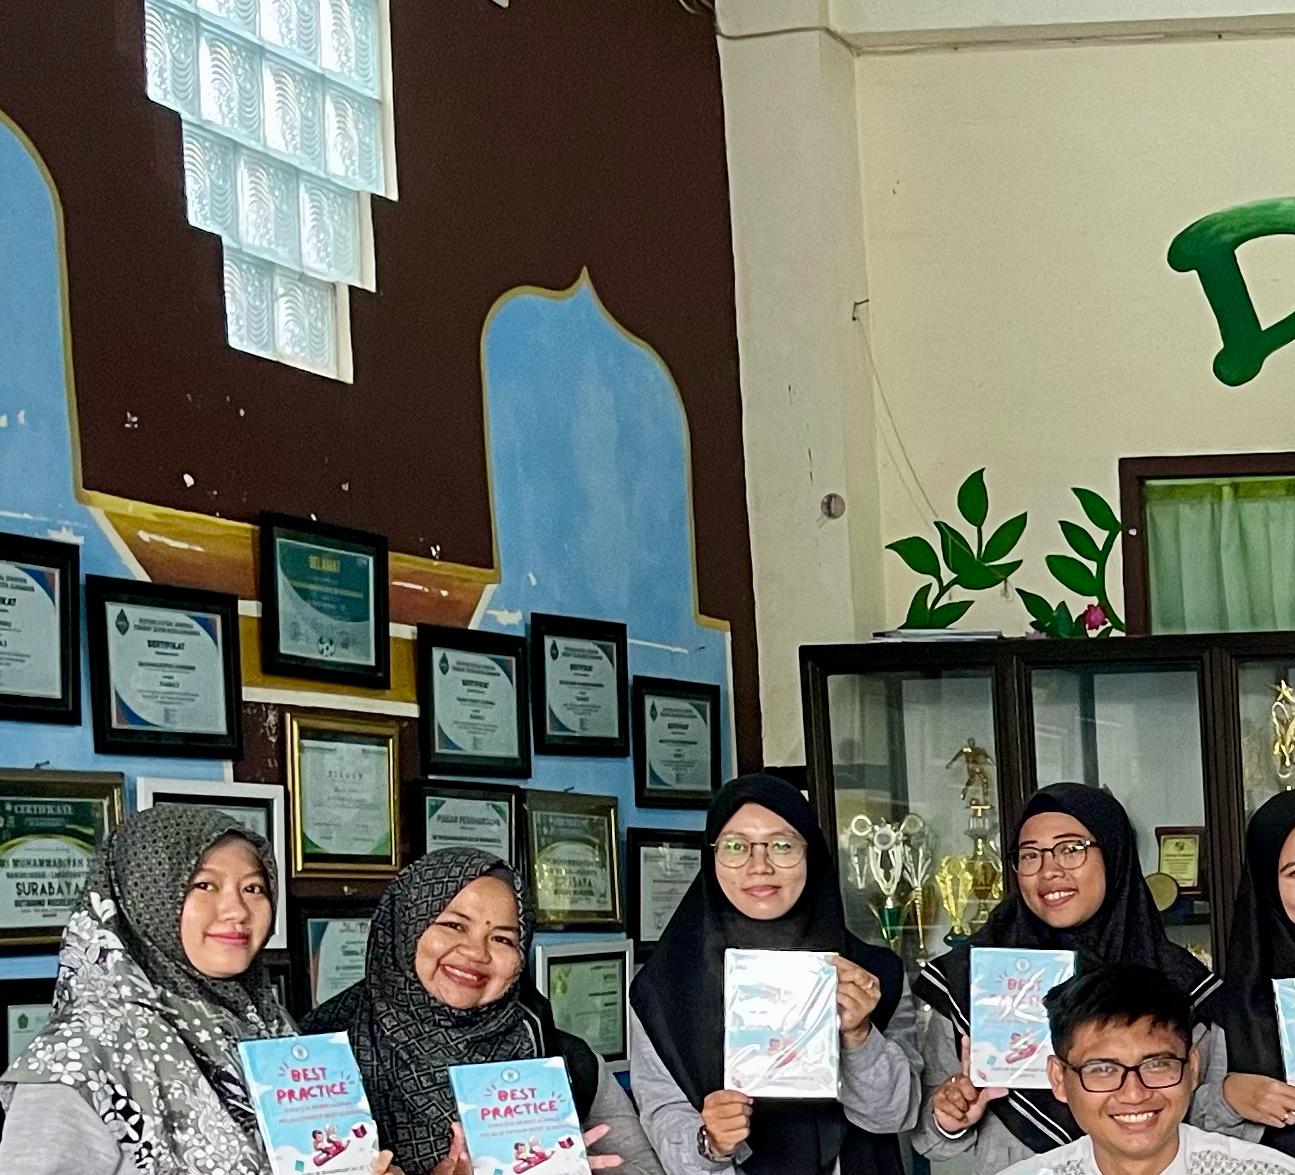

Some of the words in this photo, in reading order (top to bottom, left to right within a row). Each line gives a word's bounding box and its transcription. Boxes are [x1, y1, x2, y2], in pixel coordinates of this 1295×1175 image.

[291, 1067, 327, 1082] BEST
[276, 1081, 348, 1104] PRACTICE
[498, 1088, 537, 1102] BEST
[480, 1100, 558, 1121] PRACTICE
